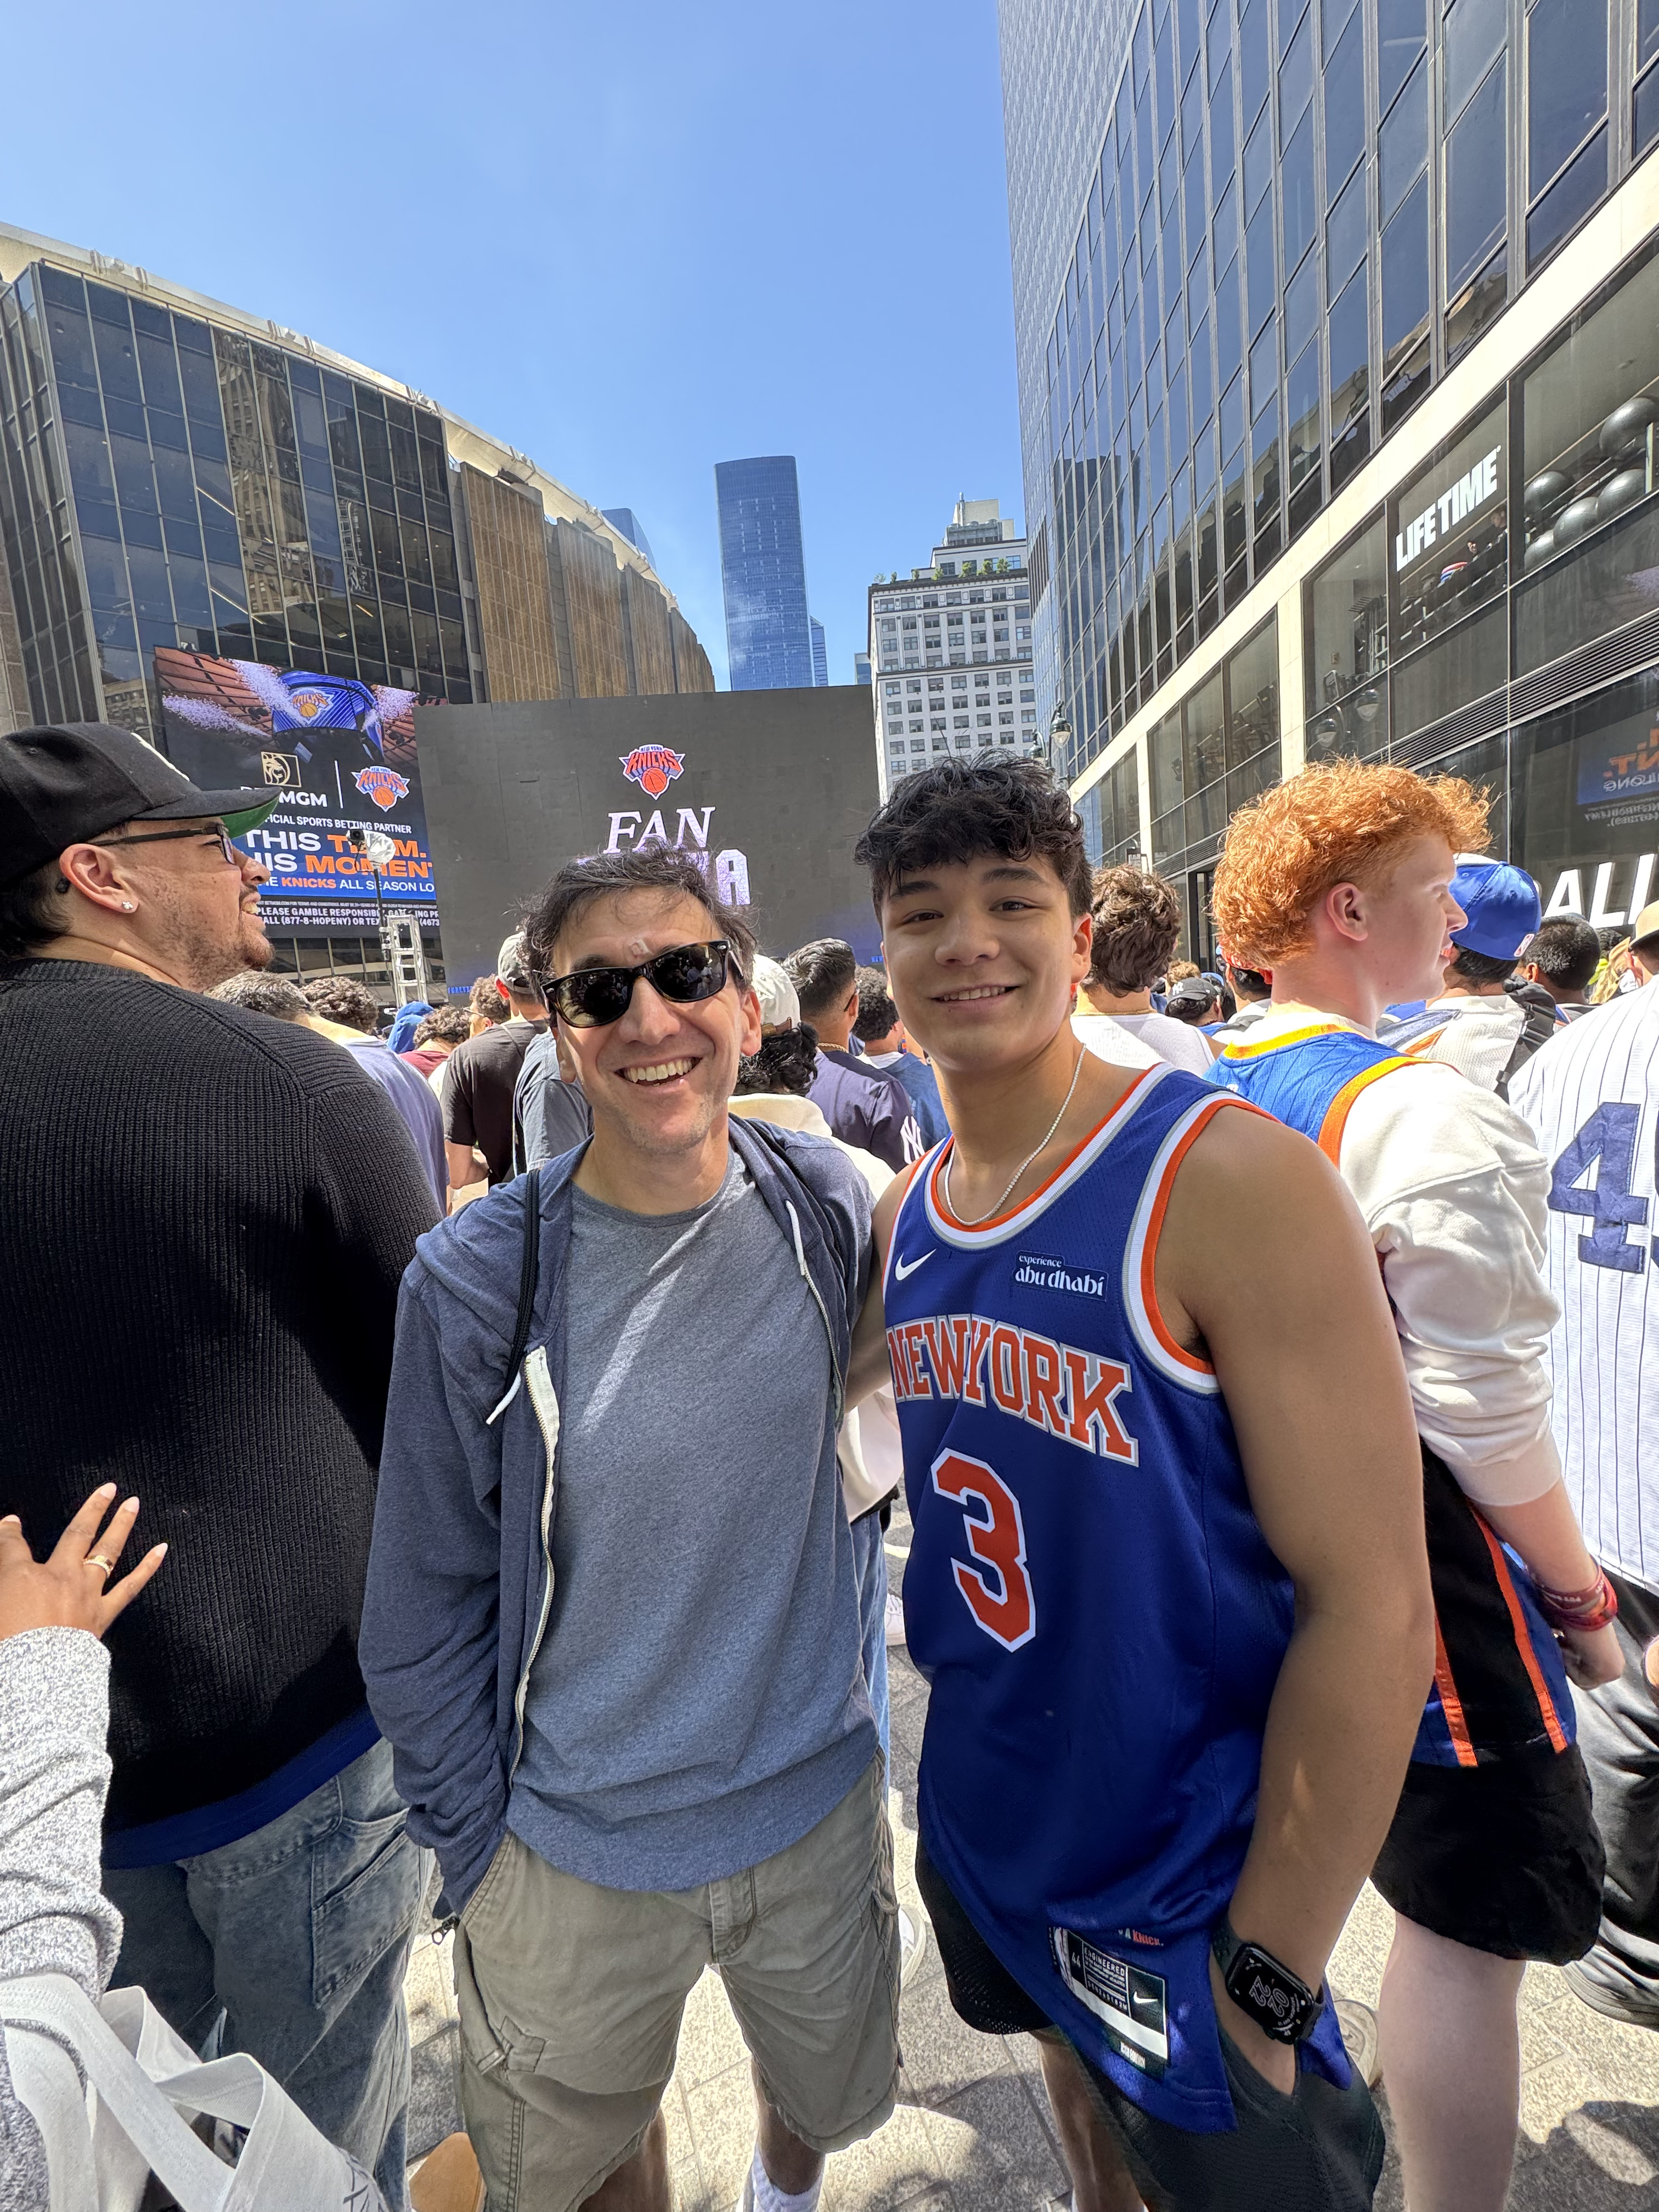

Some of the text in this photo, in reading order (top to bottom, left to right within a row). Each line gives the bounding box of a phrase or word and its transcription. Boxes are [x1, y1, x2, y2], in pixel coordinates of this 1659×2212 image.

[1396, 448, 1497, 572] LIFE TIME
[292, 693, 329, 706] KNICKS
[626, 749, 681, 775] KNICKS
[358, 770, 407, 793] KNICKS
[264, 814, 411, 834] ICIAL SPORTS BETTING PARTNER
[603, 806, 716, 853] FAN
[246, 830, 427, 858] THIS TM.
[254, 852, 432, 878] IS MOMEN
[282, 877, 336, 889] KNICKS
[339, 879, 364, 890] ALL
[366, 880, 417, 891] SEASON
[281, 917, 351, 926] (877-8-HOPENY)
[291, 908, 329, 916] GAMBLE
[388, 910, 428, 918] GAMING
[1547, 1102, 1659, 1274] 4
[1019, 1255, 1062, 1268] experience
[1015, 1266, 1105, 1296] abu dhabi
[886, 1313, 1139, 1468] NEW YORK
[931, 1447, 1036, 1652] 3
[1084, 1946, 1125, 1977] ENGINEERED
